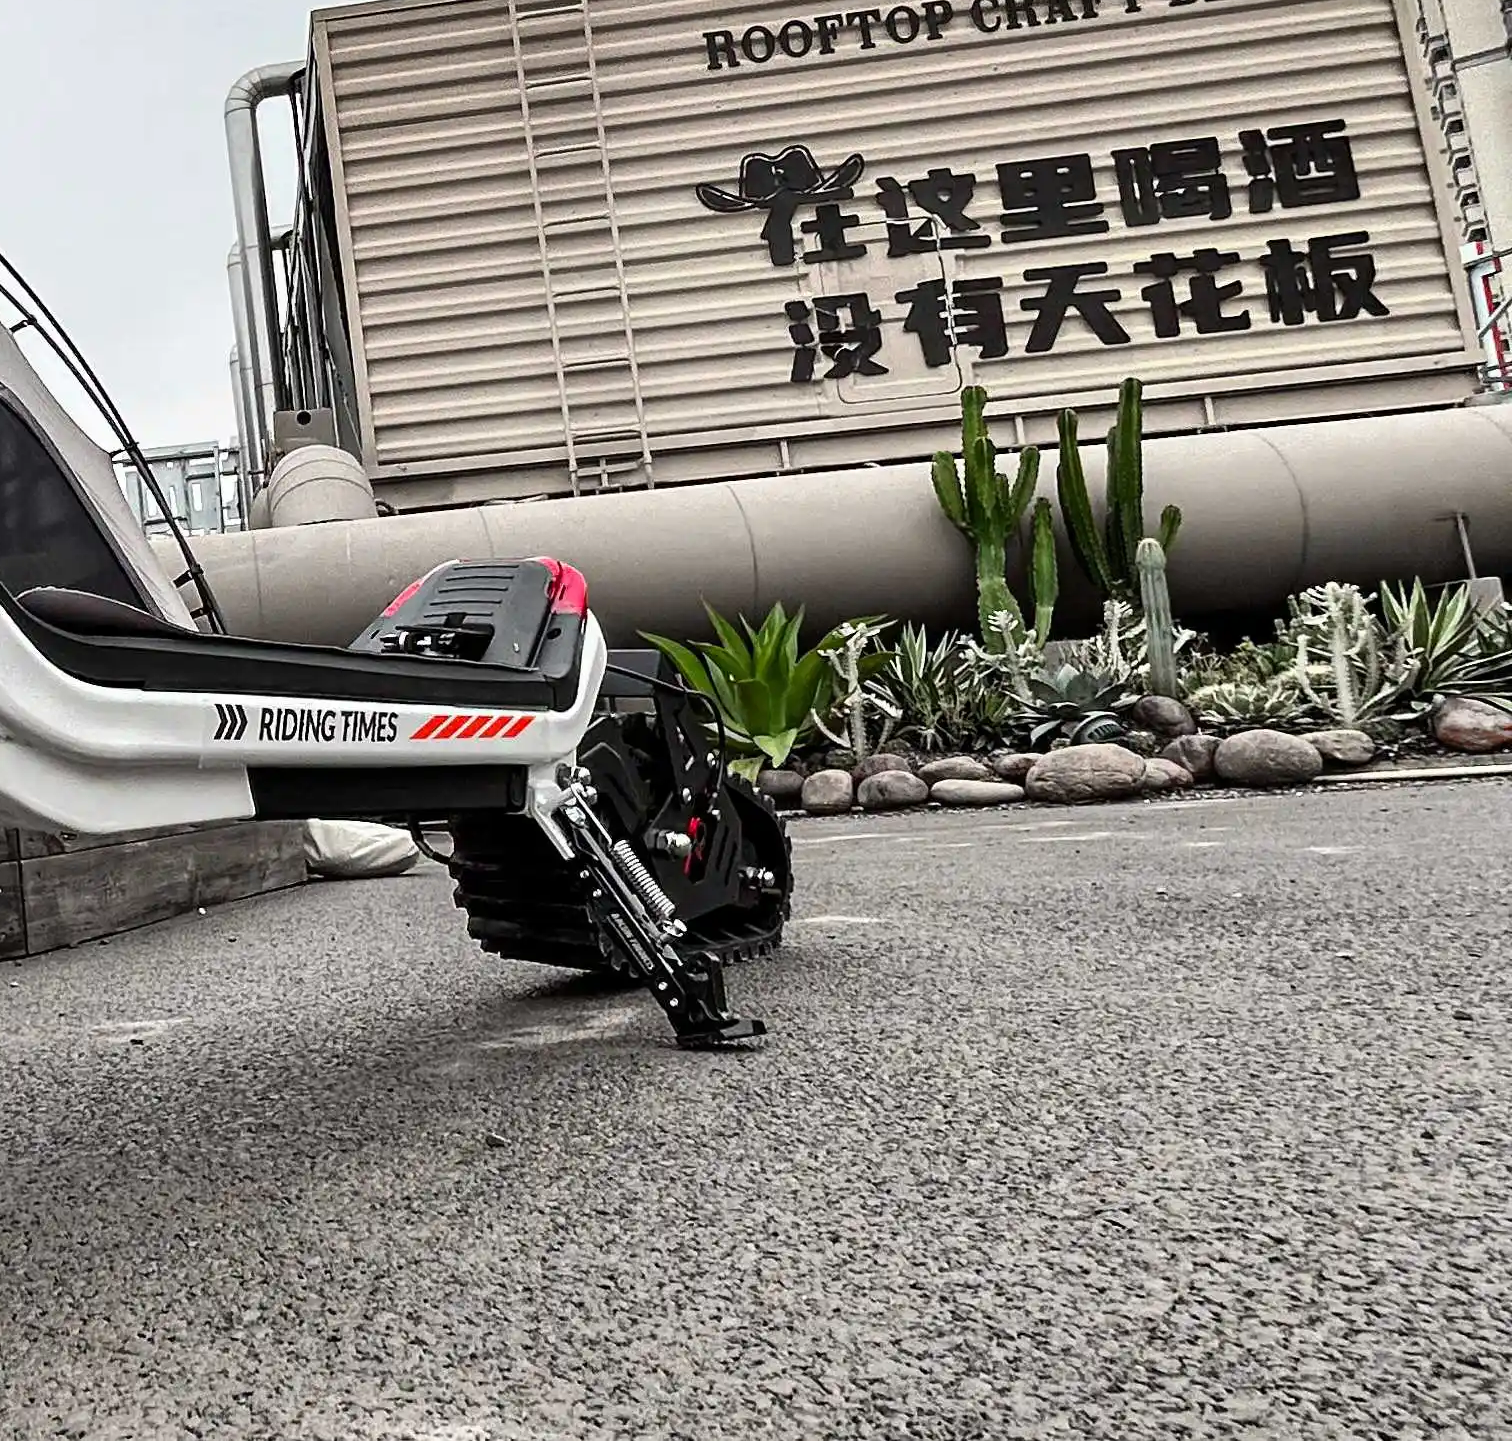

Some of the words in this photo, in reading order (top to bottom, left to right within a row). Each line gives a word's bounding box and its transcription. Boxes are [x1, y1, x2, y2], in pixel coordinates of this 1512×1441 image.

[702, 0, 954, 70] ROOFTOP
[760, 118, 1362, 266] 在这里喝酒
[784, 230, 1390, 382] 没有天花板
[259, 707, 336, 742] RIDING
[341, 711, 399, 742] TIMES
